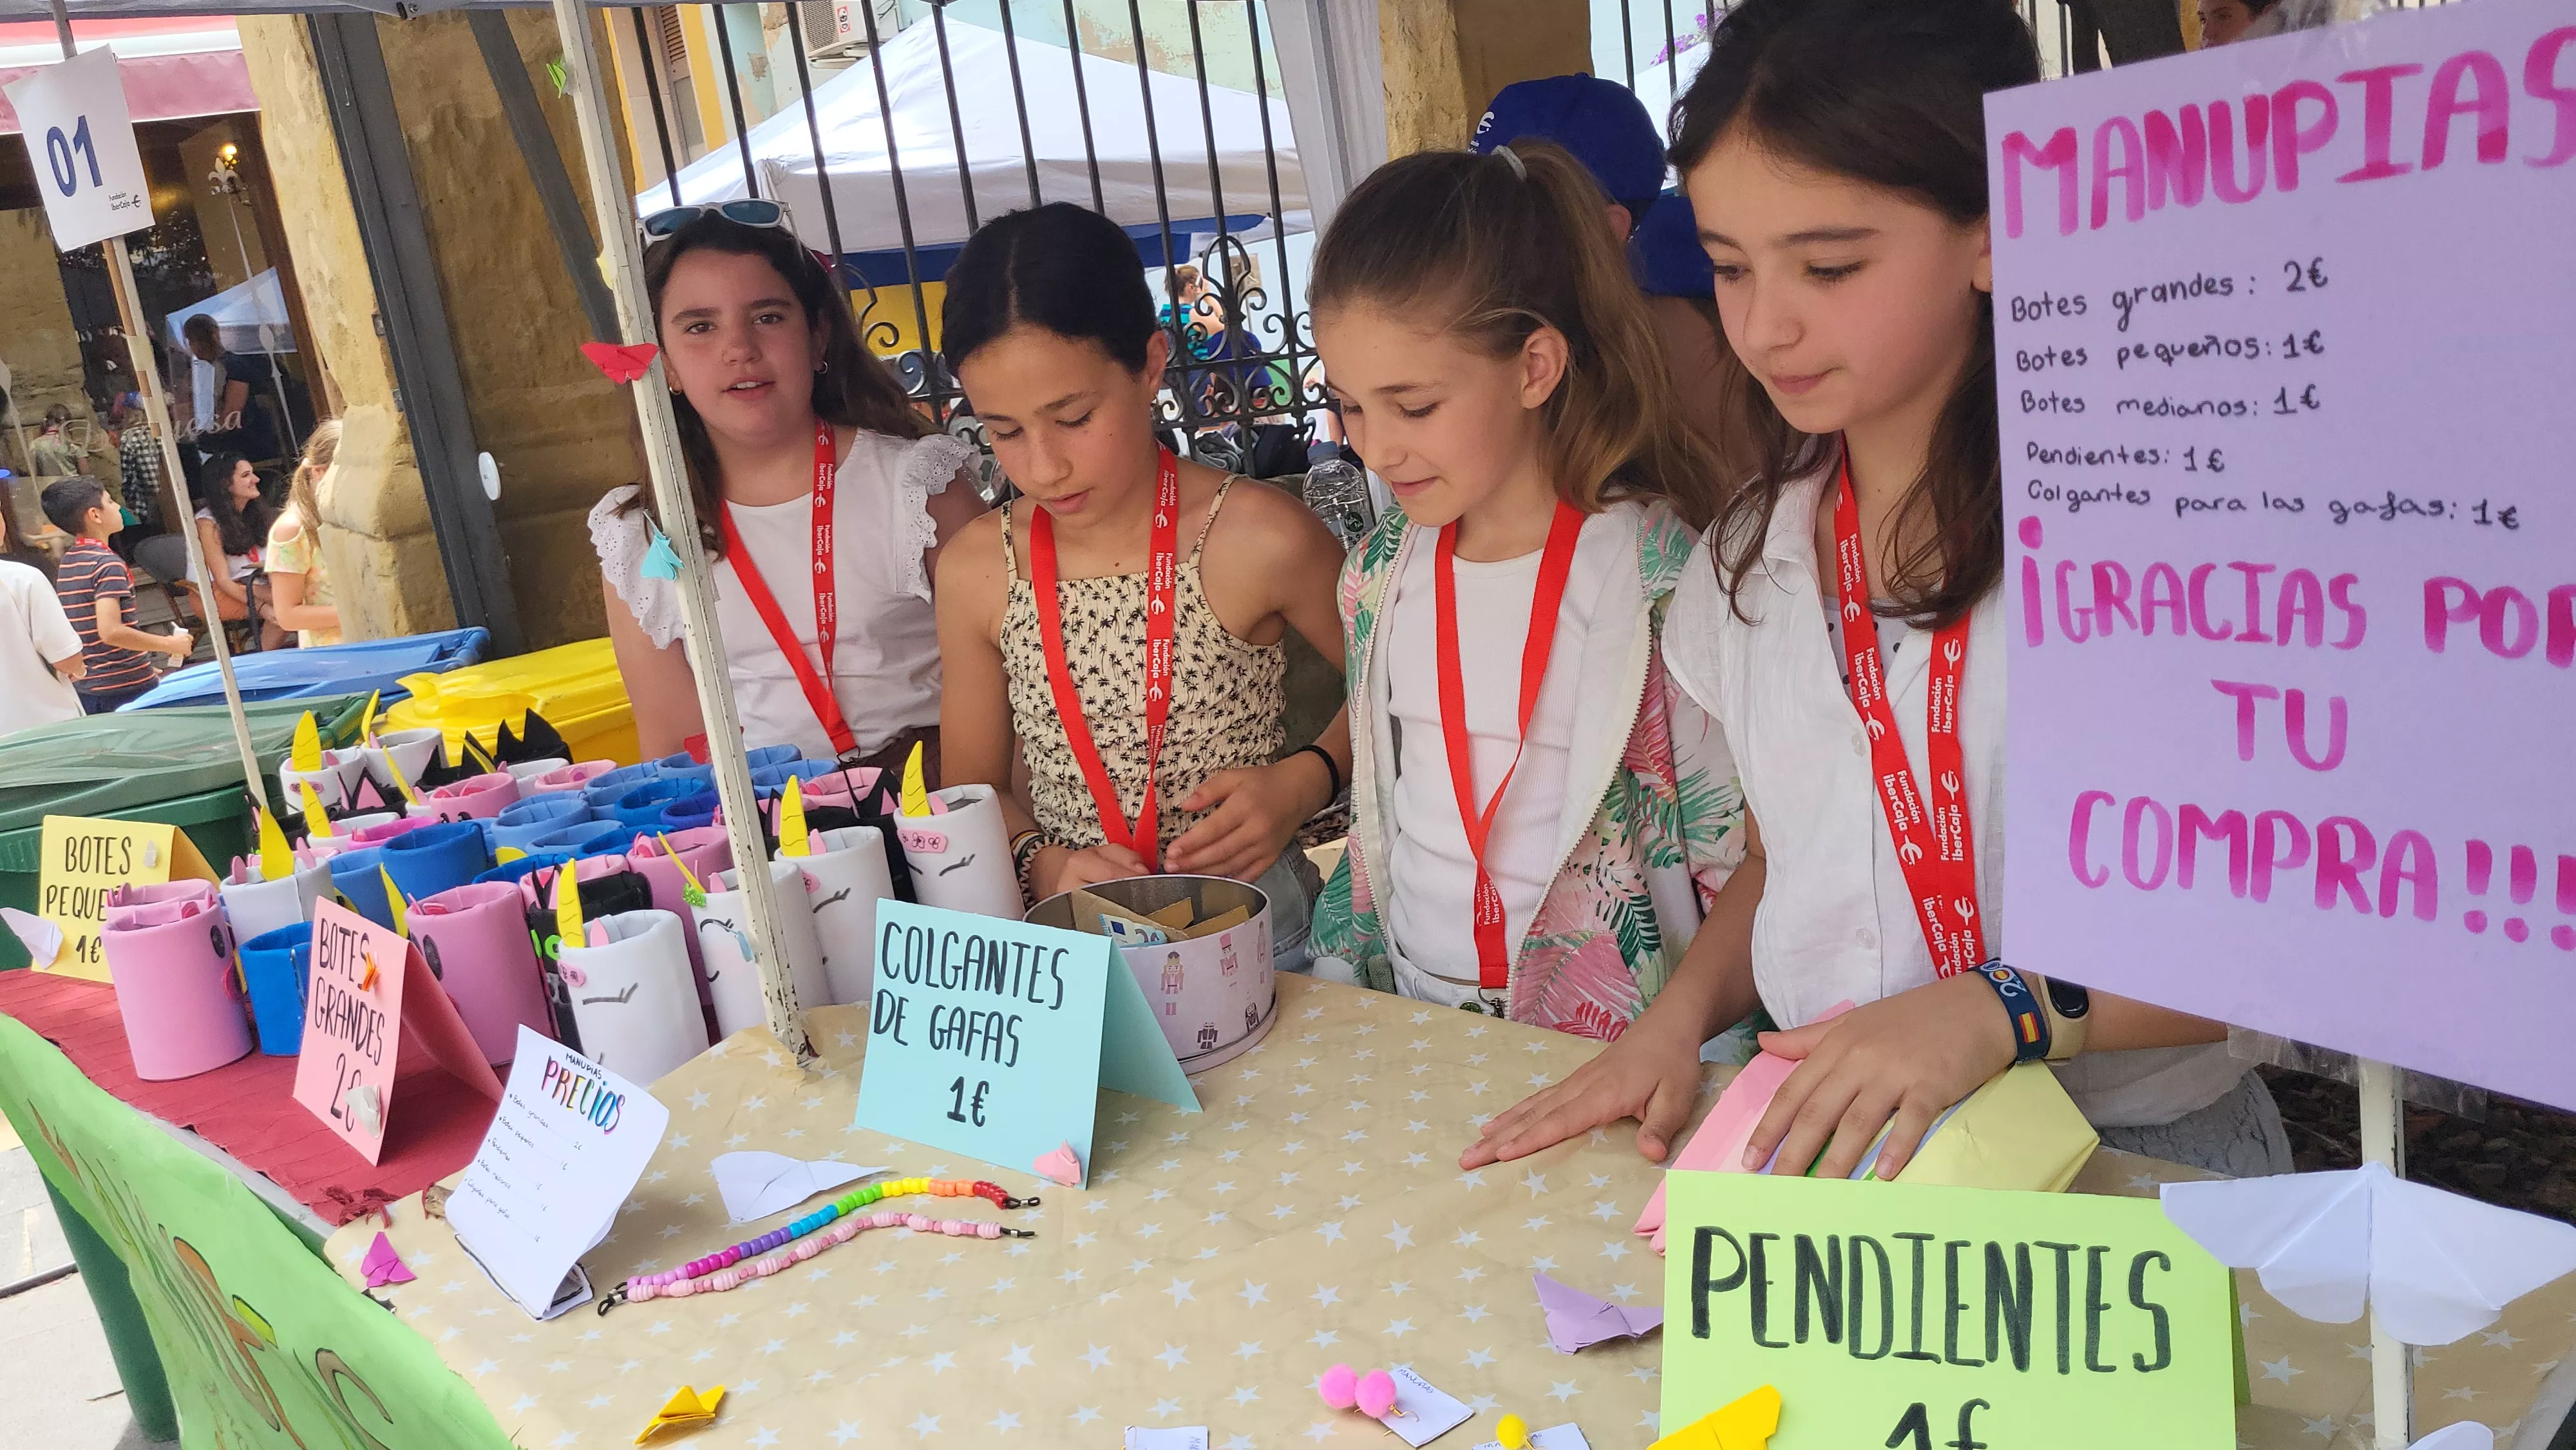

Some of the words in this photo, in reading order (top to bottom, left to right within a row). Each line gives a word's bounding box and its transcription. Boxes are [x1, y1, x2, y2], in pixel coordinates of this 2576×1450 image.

[46, 115, 104, 198] 01
[2001, 25, 2576, 240] MANUPIAS
[2011, 293, 2087, 324] Botes
[2283, 257, 2329, 293] 2€
[2016, 344, 2088, 373] Botes
[2282, 329, 2325, 360] 1€
[2020, 390, 2085, 415] Botes
[2274, 383, 2321, 415] 1€
[2026, 441, 2169, 471] Pendientes:
[2027, 479, 2152, 514] Colgantes
[2175, 494, 2246, 518] para
[2262, 485, 2305, 513] las
[2472, 502, 2521, 531] 1€
[1164, 552, 1173, 589] Fundación
[1849, 532, 1861, 583] Fundación
[1162, 638, 1171, 676] Fundación
[1866, 646, 1882, 701] Fundación
[1931, 677, 1942, 733] Fundación
[2211, 679, 2348, 771] TU
[1896, 769, 1921, 825] Fundación
[66, 836, 131, 875] BOTES
[1940, 807, 1949, 862] Fundación
[46, 884, 121, 921] PEQUE
[75, 934, 102, 963] 1€
[320, 918, 370, 991] BOTES
[882, 921, 1070, 1010] COLGANTES
[1949, 932, 1962, 975] ndación
[1961, 930, 1976, 968] rCaja
[314, 976, 384, 1066] GRANDES
[874, 989, 909, 1046] DE
[930, 1004, 1023, 1068] GAFAS
[947, 1076, 989, 1127] 1€
[1690, 1225, 2173, 1375] PENDIENTES
